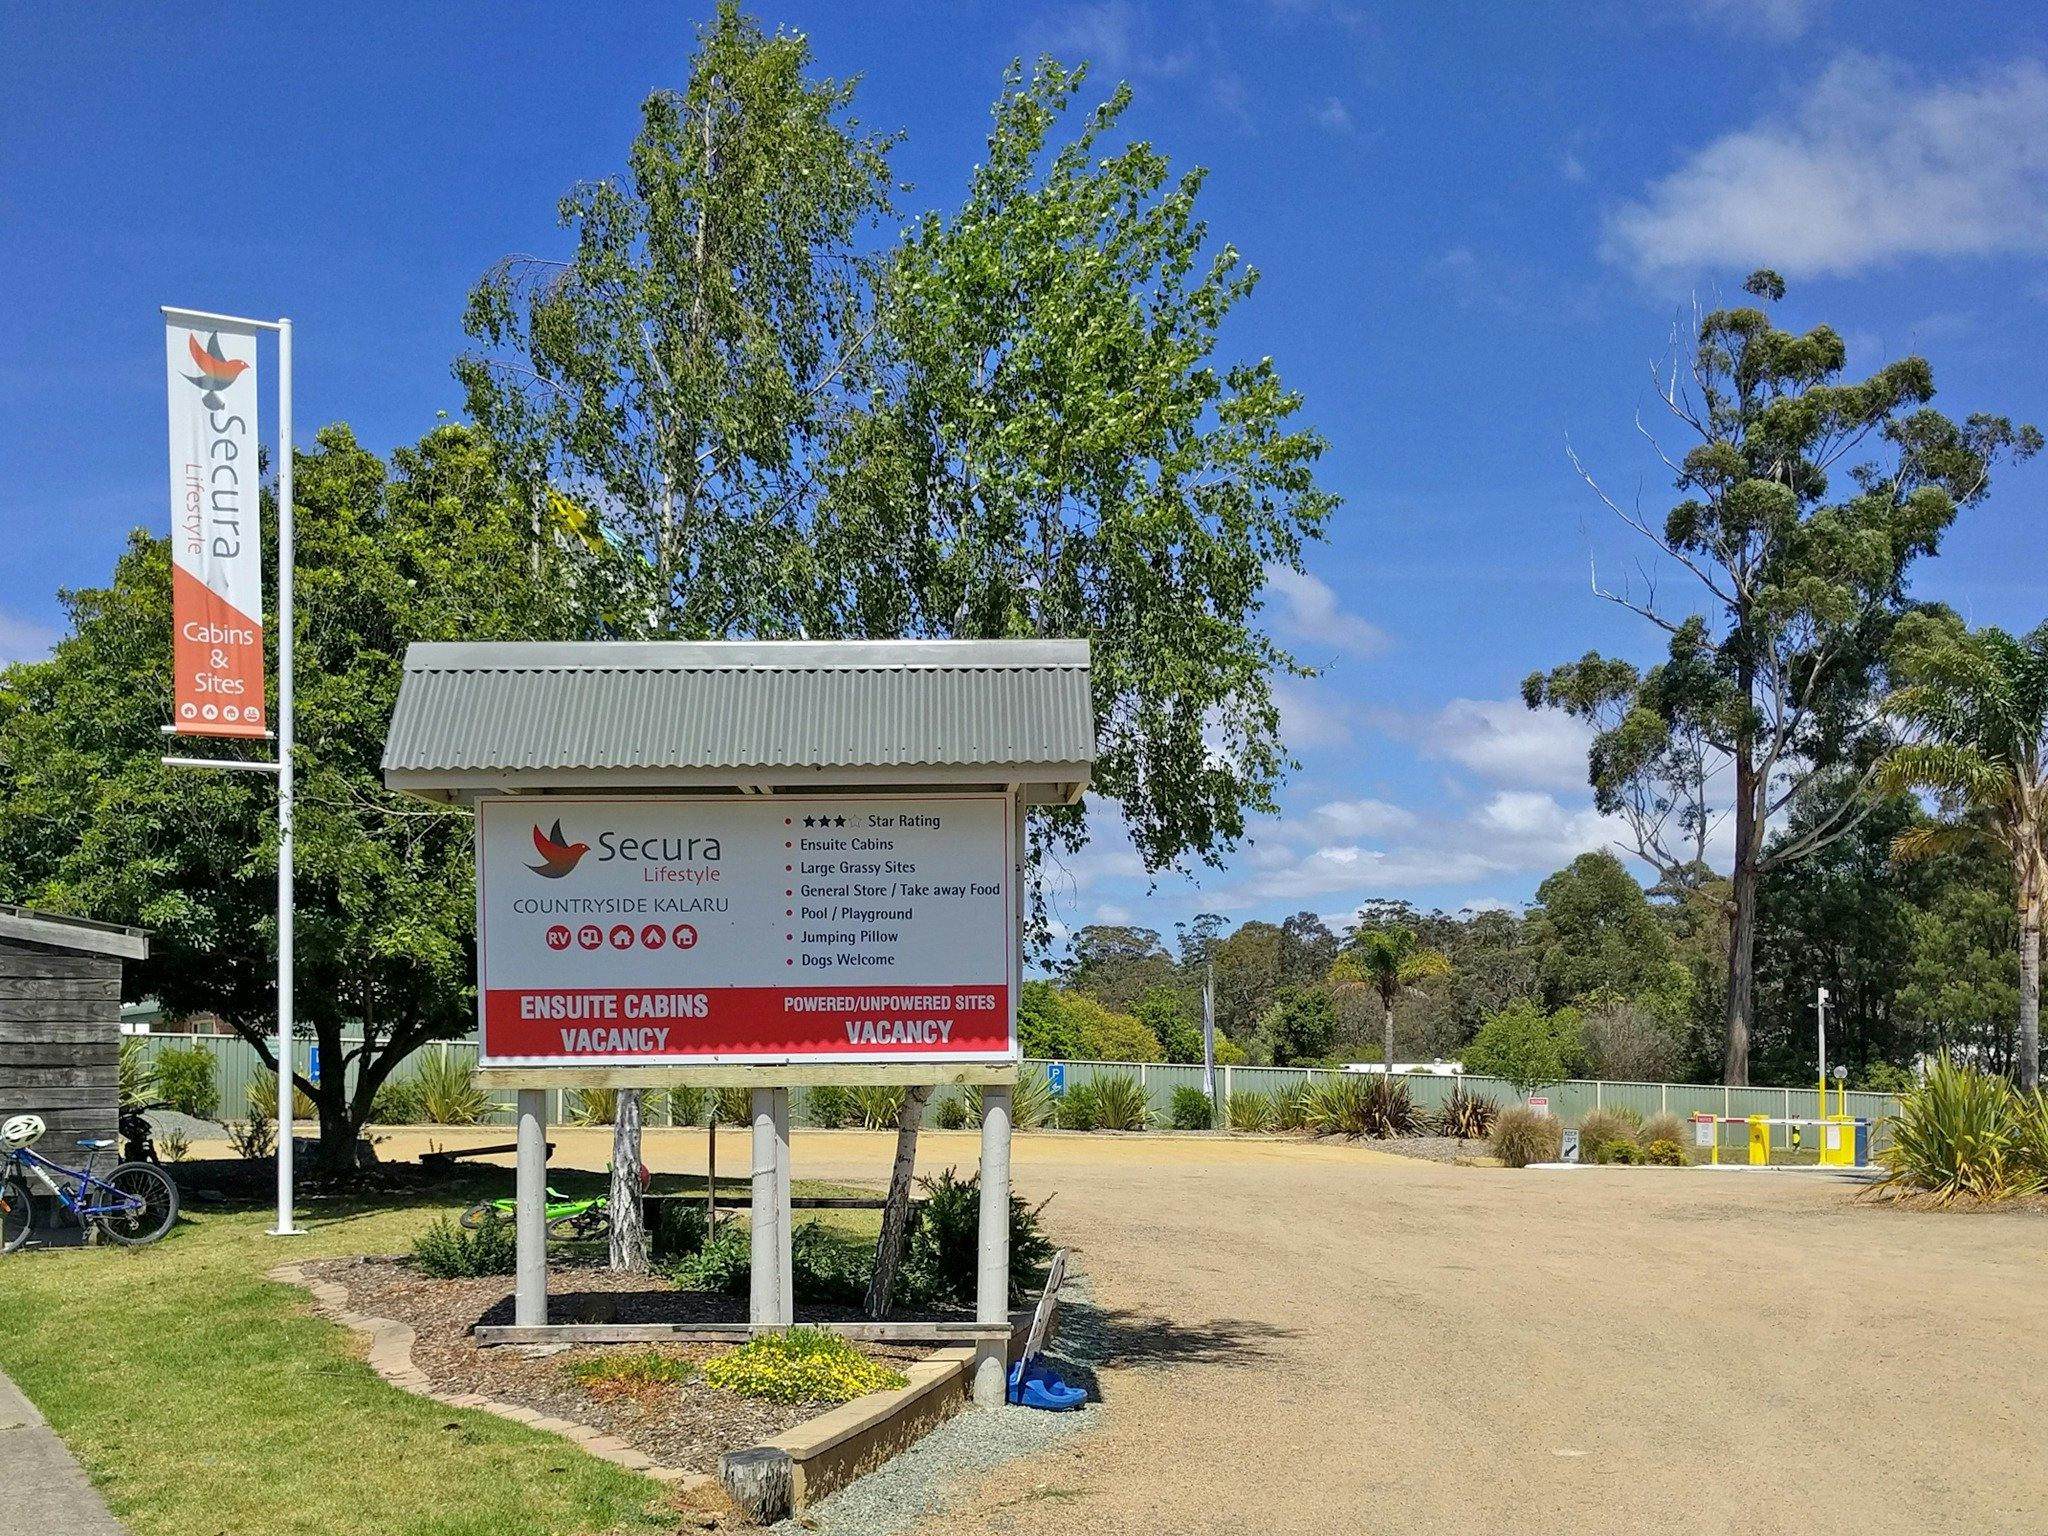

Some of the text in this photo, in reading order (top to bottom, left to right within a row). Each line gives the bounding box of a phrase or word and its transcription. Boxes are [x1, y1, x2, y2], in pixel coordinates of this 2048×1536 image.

[209, 413, 247, 559] Secura
[182, 463, 206, 555] Lifestyle
[183, 621, 254, 645] Cabins
[210, 648, 229, 669] &
[194, 672, 245, 695] Sites
[868, 814, 941, 830] Star Rating
[598, 831, 721, 861] Secura
[800, 837, 894, 851] Ensuite Cabins
[644, 866, 720, 886] Lifestyle
[800, 860, 916, 877] Large Grassy Sites
[801, 883, 1000, 898] General Store / Take away Food
[513, 897, 729, 914] COUNTRYSIDE KALARU
[801, 906, 913, 923] Pool / Playground
[548, 931, 569, 945] RV
[800, 930, 899, 945] Jumping Pillow
[802, 953, 895, 969] Dogs Welcome
[520, 994, 709, 1020] ENSUITE CABINS
[784, 995, 996, 1012] POWERED/UNPOWERED SITES
[560, 1027, 670, 1052] VACANCY
[845, 1020, 954, 1045] VACANCY
[1052, 1068, 1060, 1080] P
